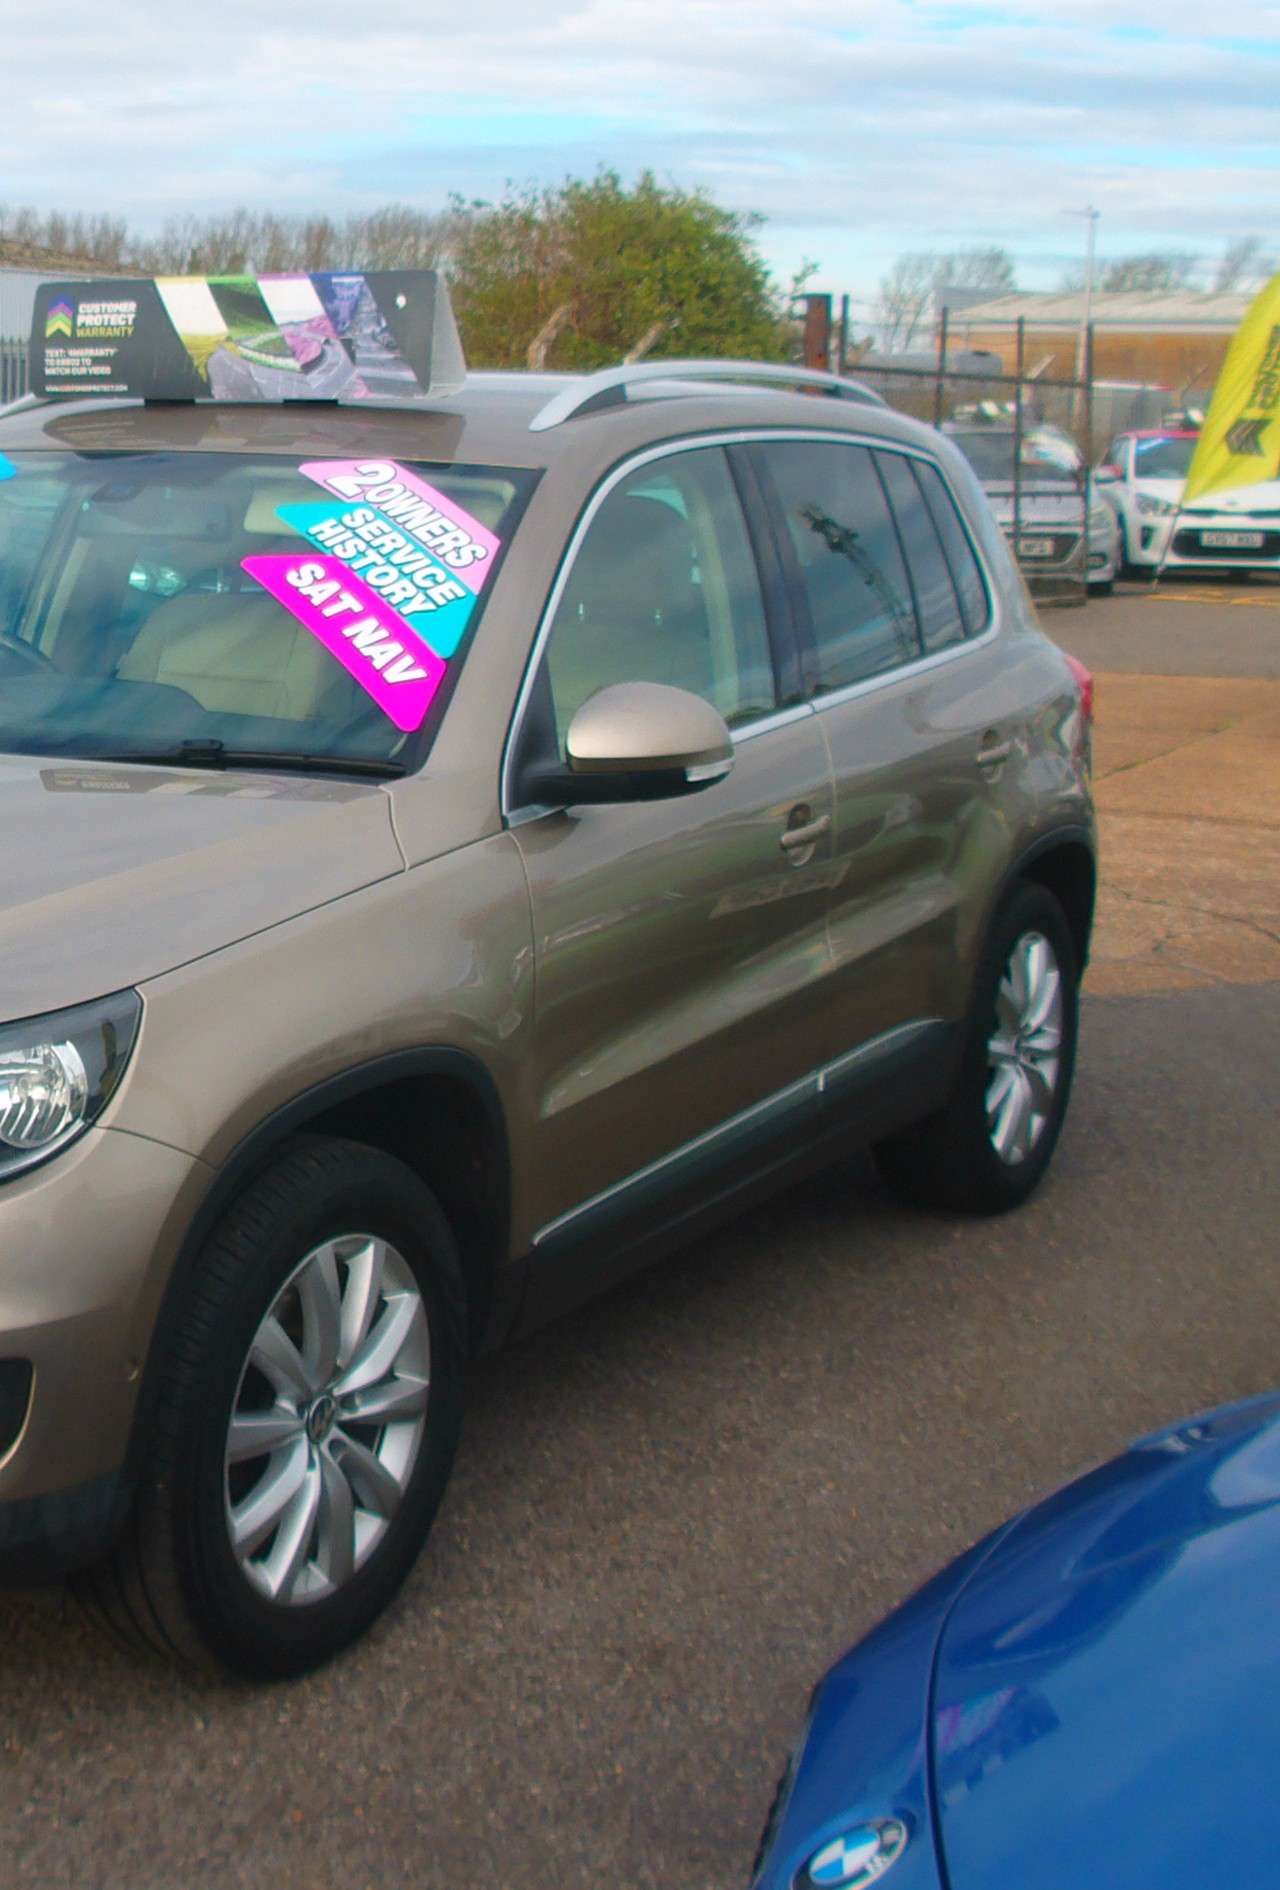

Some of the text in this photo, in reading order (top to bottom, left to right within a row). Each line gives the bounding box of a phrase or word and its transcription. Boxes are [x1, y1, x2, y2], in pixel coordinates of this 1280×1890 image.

[76, 313, 136, 326] PROTECT
[76, 326, 135, 337] WARRANTY
[78, 301, 137, 314] CUSTOMER
[325, 463, 490, 569] 2 OWNERS
[342, 508, 467, 607] SERVICE
[307, 517, 438, 617] HISTORY
[285, 562, 429, 685] SAT NAV
